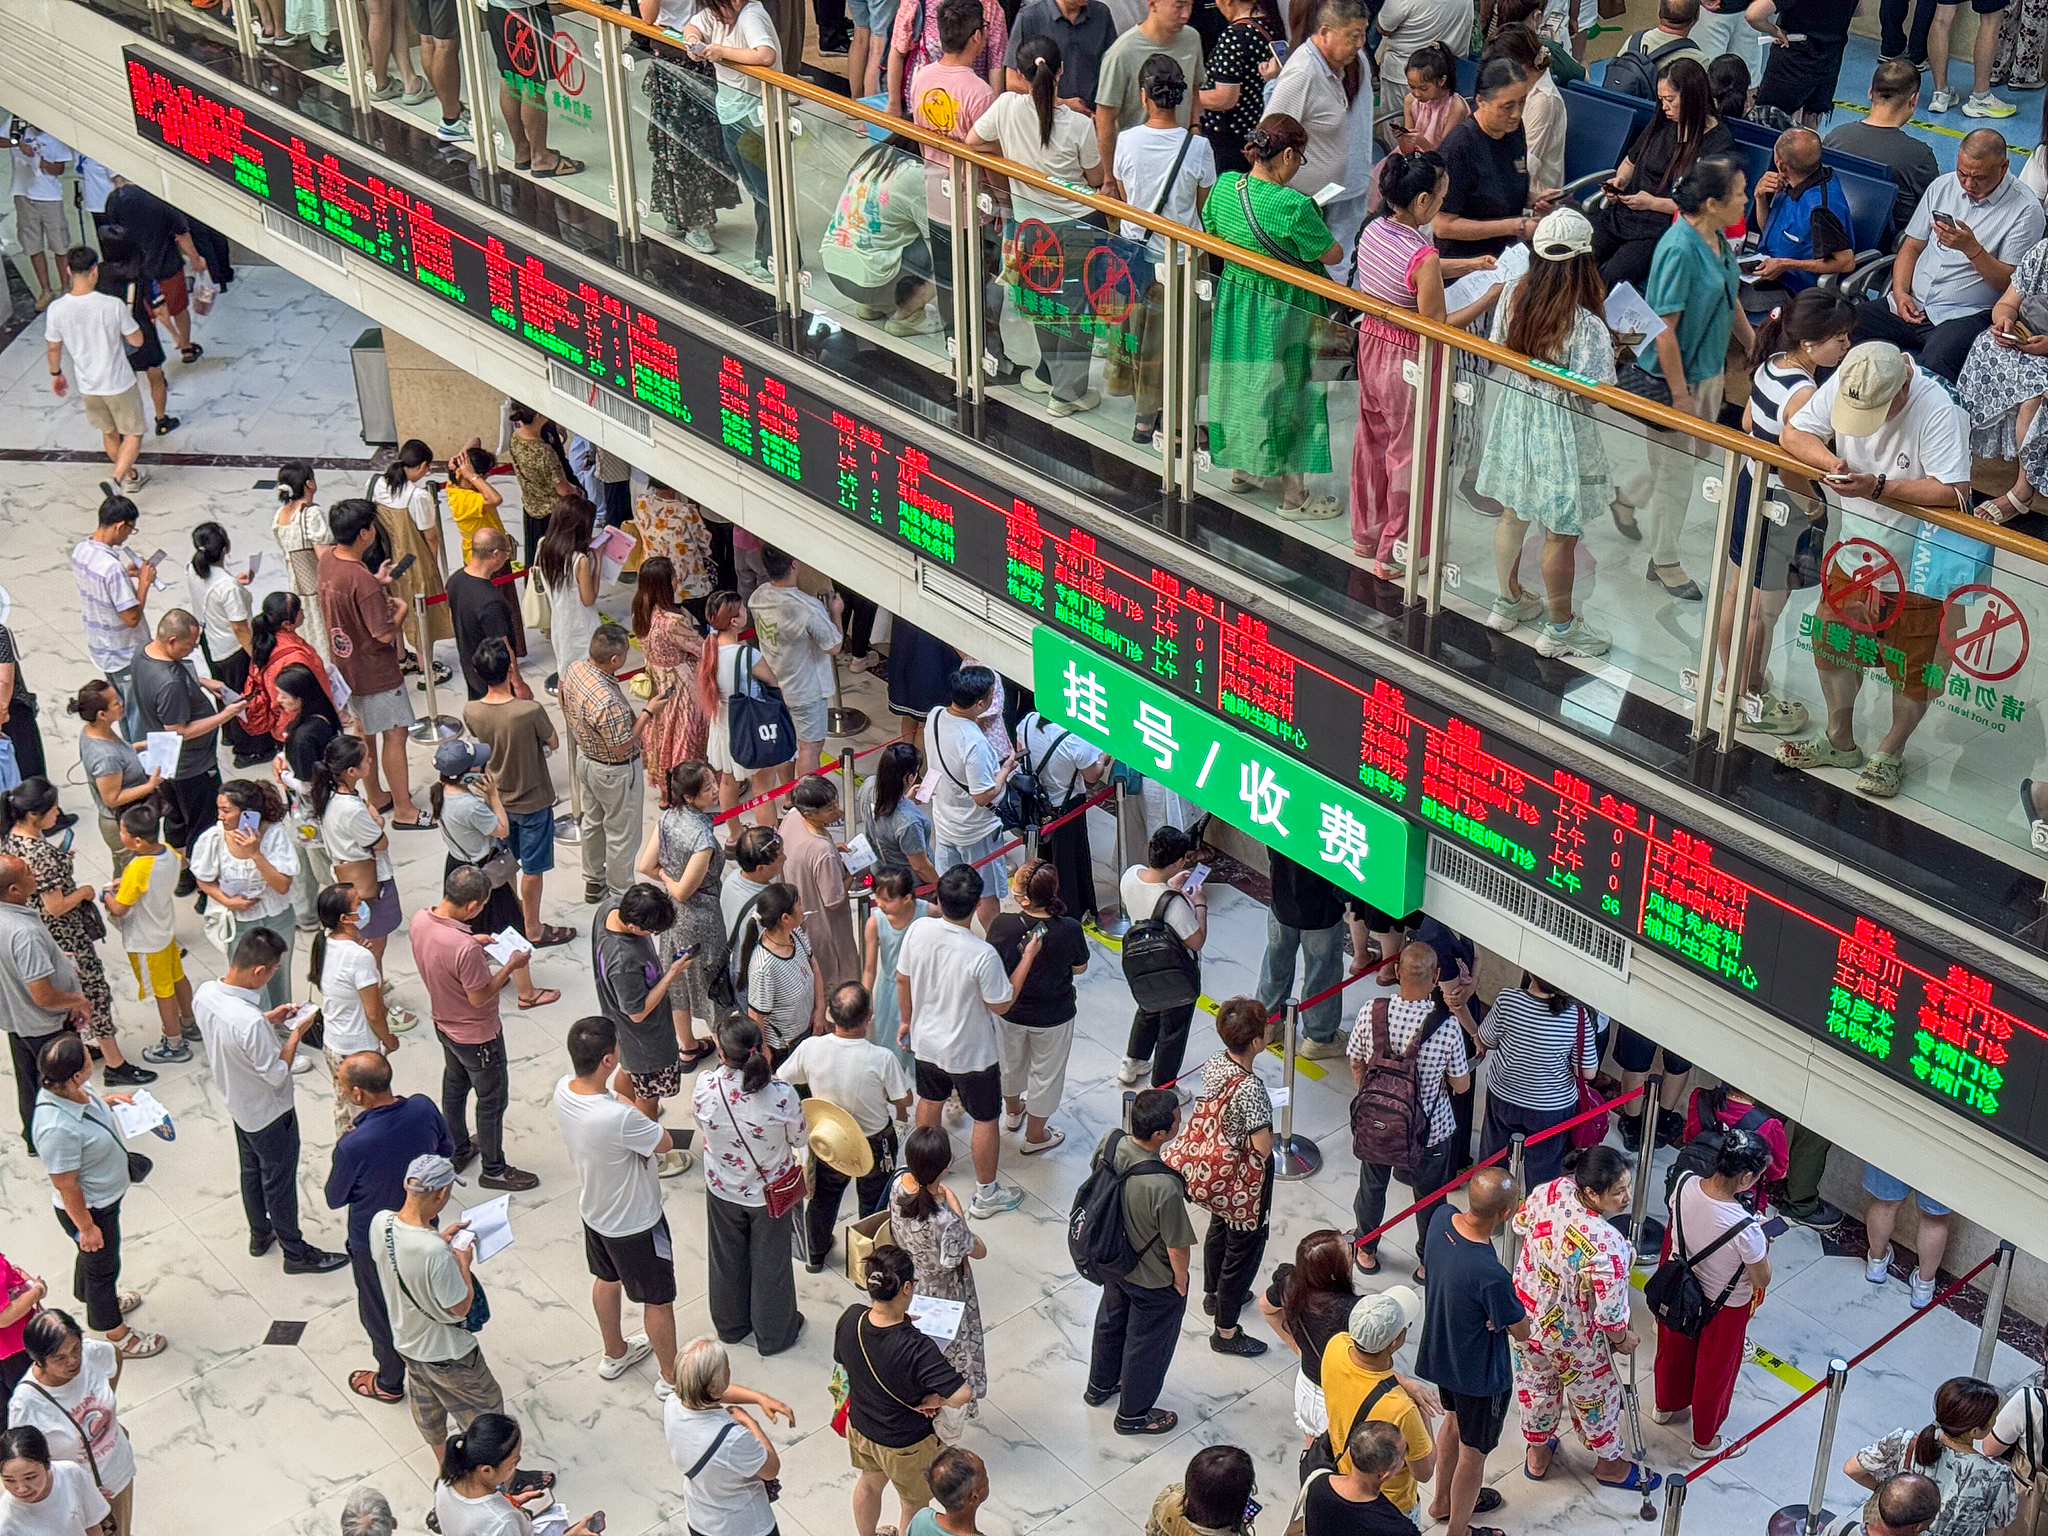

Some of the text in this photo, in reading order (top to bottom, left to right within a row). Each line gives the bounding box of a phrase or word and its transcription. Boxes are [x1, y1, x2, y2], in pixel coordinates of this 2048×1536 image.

[897, 500, 955, 544] 风湿免疫科
[1054, 582, 1105, 622] 专病门诊
[1151, 634, 1179, 659] 上午
[1195, 659, 1203, 674] 4
[898, 519, 955, 564] 风湿免疫科
[1054, 601, 1144, 662] 副主任医师门诊
[1151, 655, 1179, 679] 上午
[1194, 679, 1202, 693] 1
[1054, 542, 1105, 581] 专病门诊
[1151, 593, 1179, 617] 上午
[1196, 616, 1204, 631] 0
[1054, 562, 1144, 622] 副主任医师门诊
[1151, 614, 1179, 639] 上午
[1196, 638, 1204, 652] 0
[1151, 568, 1180, 597] 时间
[1186, 586, 1215, 614] 余号
[1063, 659, 1369, 882] 挂号/收费
[1221, 690, 1620, 916] 辅助生殖中心 胡翠芳 副主任医师门诊 上午 36
[1222, 670, 1294, 723] 风湿免疫科
[1422, 774, 1489, 821] 普通门诊
[1548, 843, 1584, 871] 上午
[1608, 874, 1619, 890] 0
[1223, 648, 1294, 701] 耳鼻咽喉科
[1423, 752, 1541, 825] 副主任医师门诊
[1550, 820, 1587, 848] 上午
[1610, 852, 1621, 868] 0
[1224, 626, 1296, 680] 耳鼻咽喉科
[1425, 731, 1525, 794] 主任医师门诊
[1553, 798, 1588, 825] 上午
[1613, 828, 1624, 845] 0
[1553, 769, 1591, 803] 时间
[1600, 794, 1638, 826] 余号
[1643, 914, 2000, 1114] 辅助生殖中心 杨晓涛 专病门诊
[1646, 892, 2005, 1089] 风湿免疫科 杨彦龙 专病门诊
[1648, 868, 2009, 1065] 耳鼻咽喉科 王旭东 普通门诊
[1652, 845, 2014, 1040] 耳鼻咽喉科 陈继川 专病门诊
[1672, 829, 1992, 1003] 科室 医生 类别
